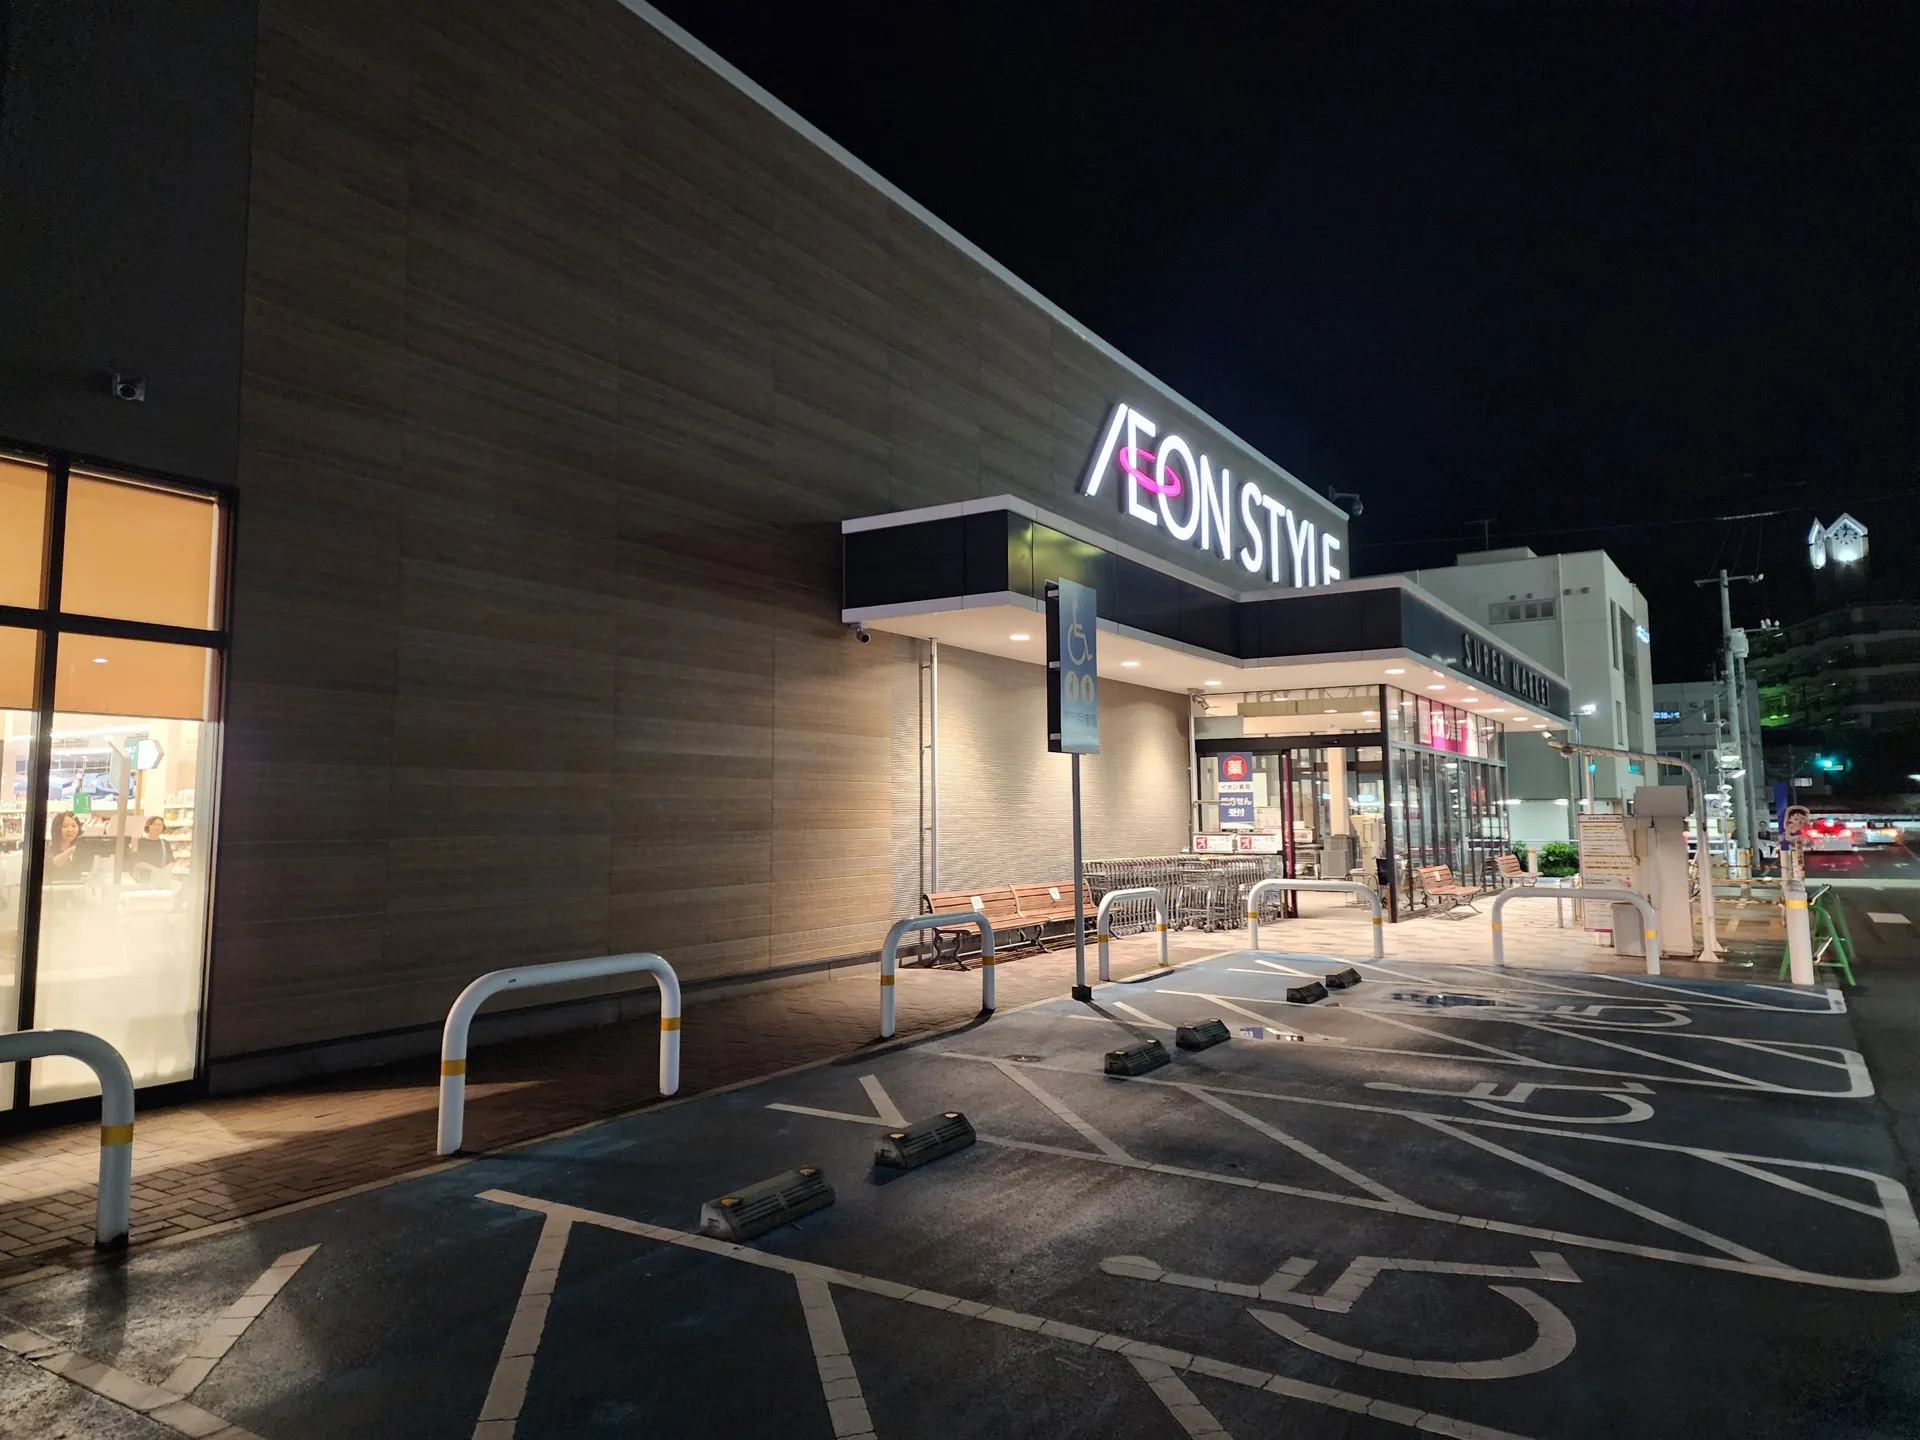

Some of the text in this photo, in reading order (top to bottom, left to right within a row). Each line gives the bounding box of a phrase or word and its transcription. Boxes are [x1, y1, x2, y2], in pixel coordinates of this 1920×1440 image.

[1464, 633, 1550, 707] SUPER MARKET
[1227, 760, 1242, 775] 薬
[1228, 808, 1245, 817] 受付
